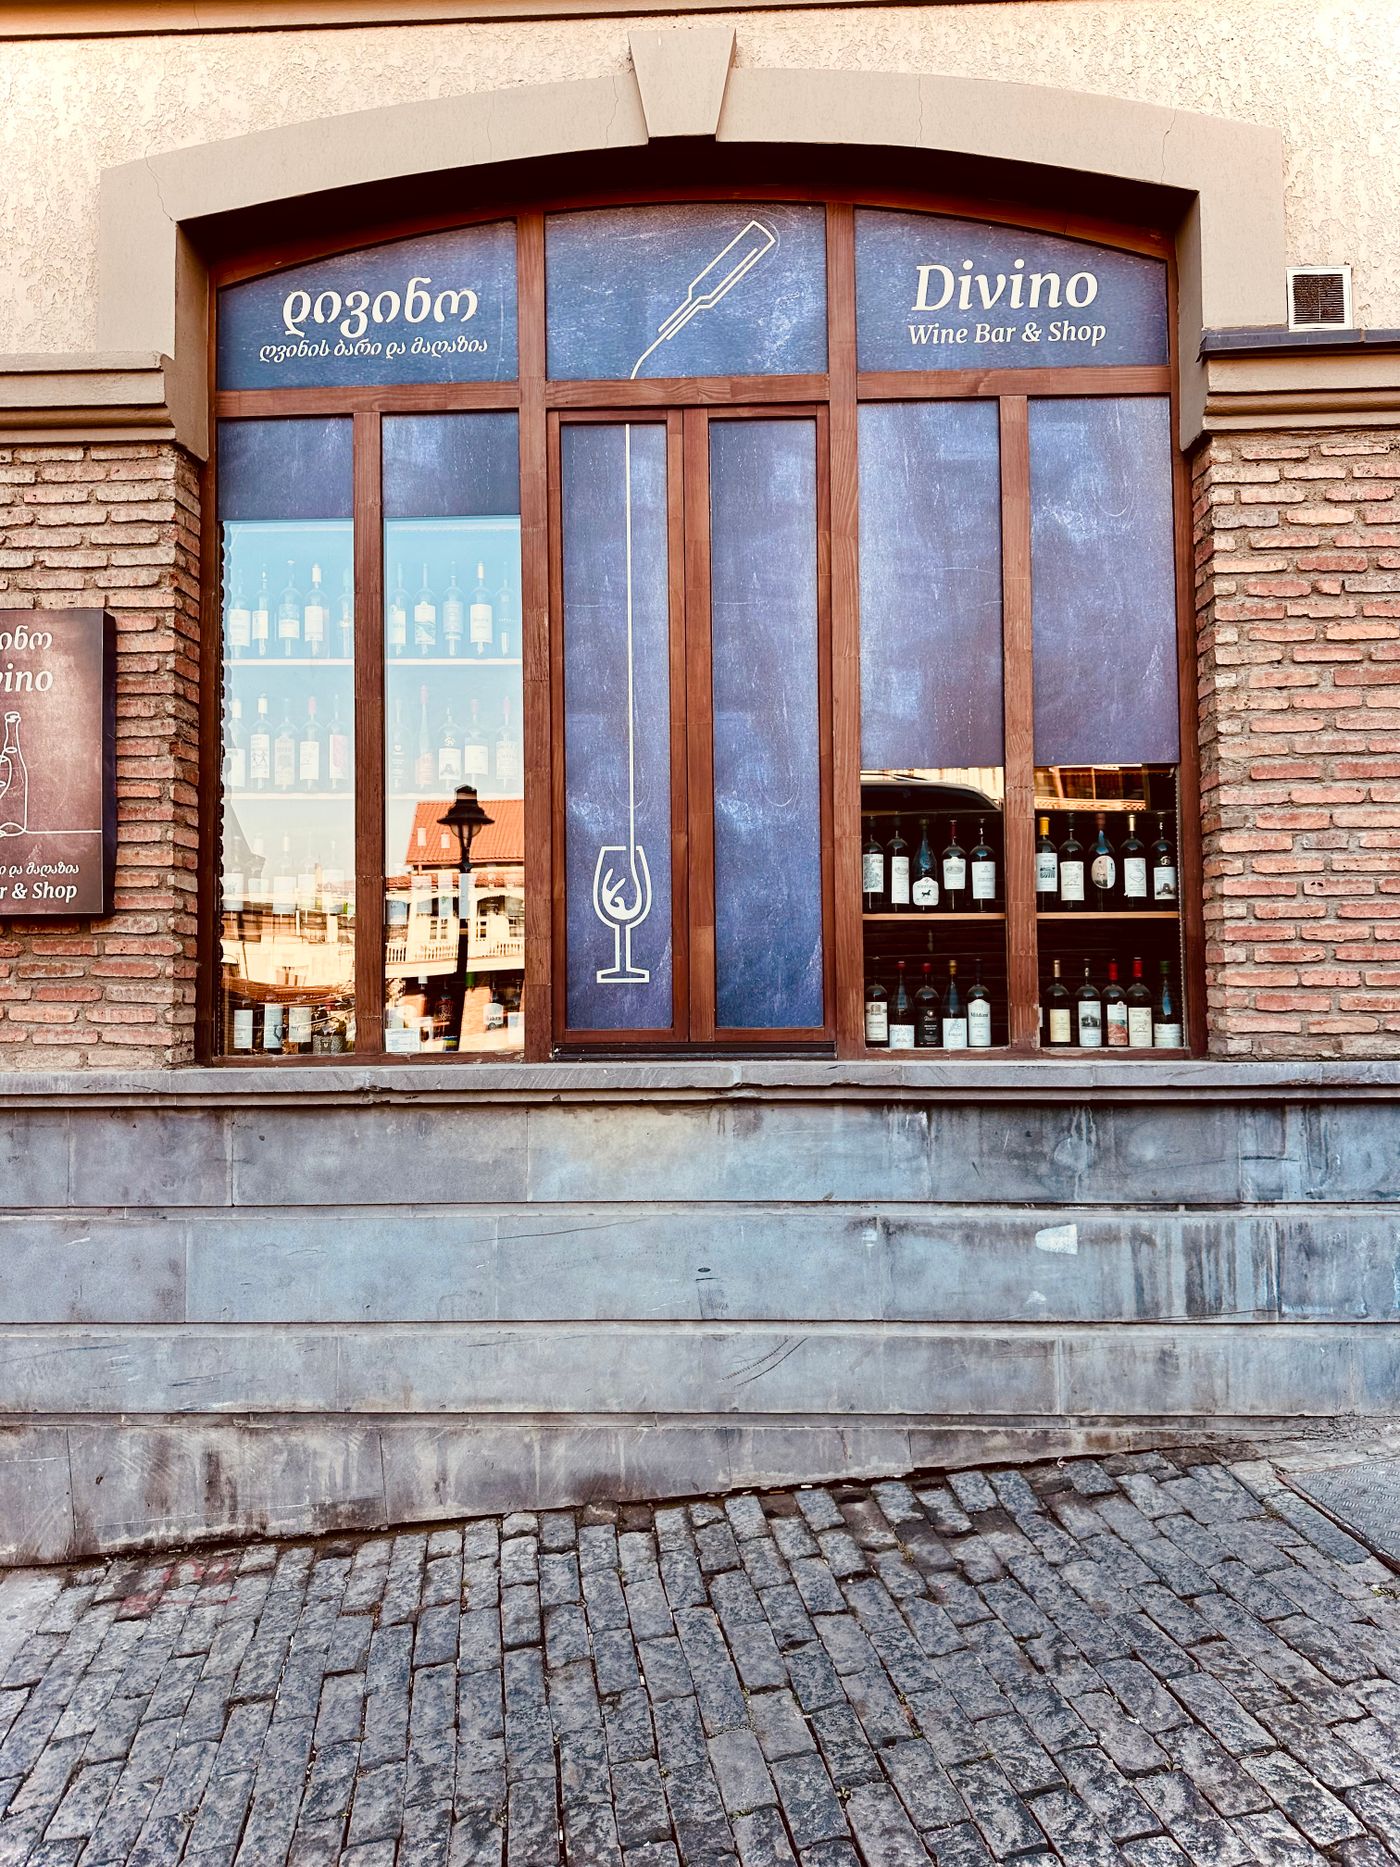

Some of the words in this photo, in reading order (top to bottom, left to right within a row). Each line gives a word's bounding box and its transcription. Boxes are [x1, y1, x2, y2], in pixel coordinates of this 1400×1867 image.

[911, 258, 1098, 312] Divino
[283, 276, 479, 339] დივინო
[908, 323, 968, 344] Wine
[974, 323, 1017, 343] Bar
[1021, 321, 1042, 342] &
[1047, 319, 1107, 347] Shop
[259, 339, 331, 362] ღვინის
[333, 338, 383, 356] ბარი
[386, 342, 406, 359] და
[410, 335, 488, 358] მაღაზია
[8, 865, 23, 878] და
[26, 861, 80, 878] მაღაზია
[12, 882, 28, 899] &
[32, 881, 78, 904] Shop
